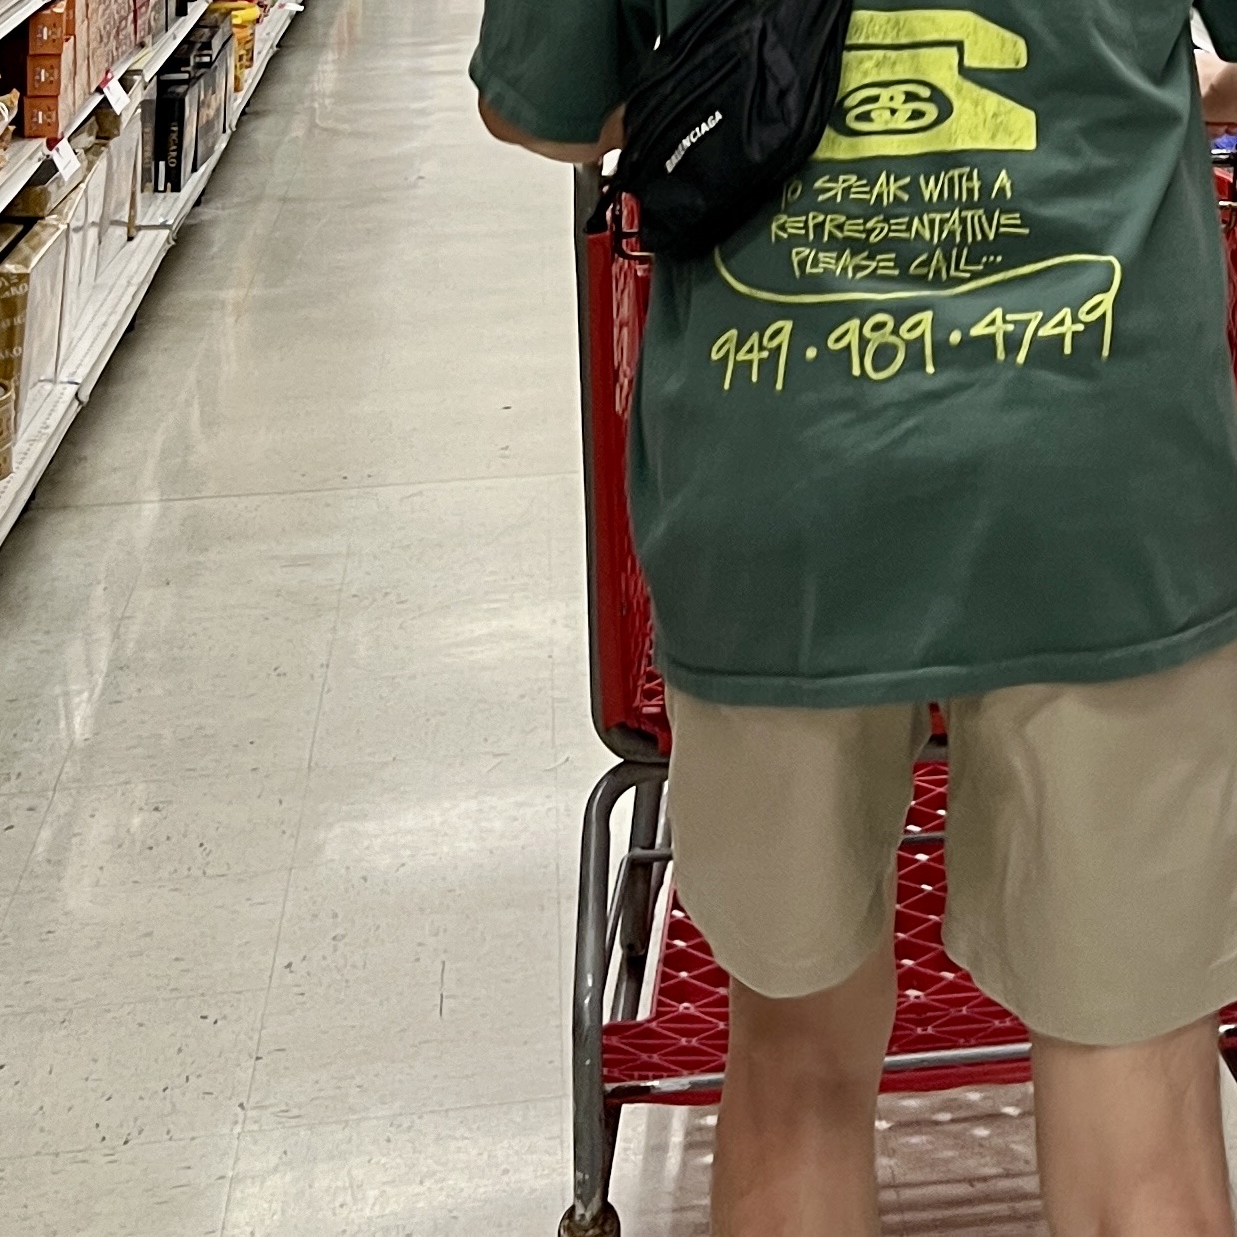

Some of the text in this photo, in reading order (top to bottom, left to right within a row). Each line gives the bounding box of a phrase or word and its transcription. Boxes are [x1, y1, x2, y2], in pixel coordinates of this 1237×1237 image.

[813, 169, 910, 207] SPEAK
[920, 167, 981, 203] WITH
[991, 168, 1012, 200] A
[771, 206, 1030, 245] REPRESENTATIVE
[791, 246, 899, 280] PLEASE
